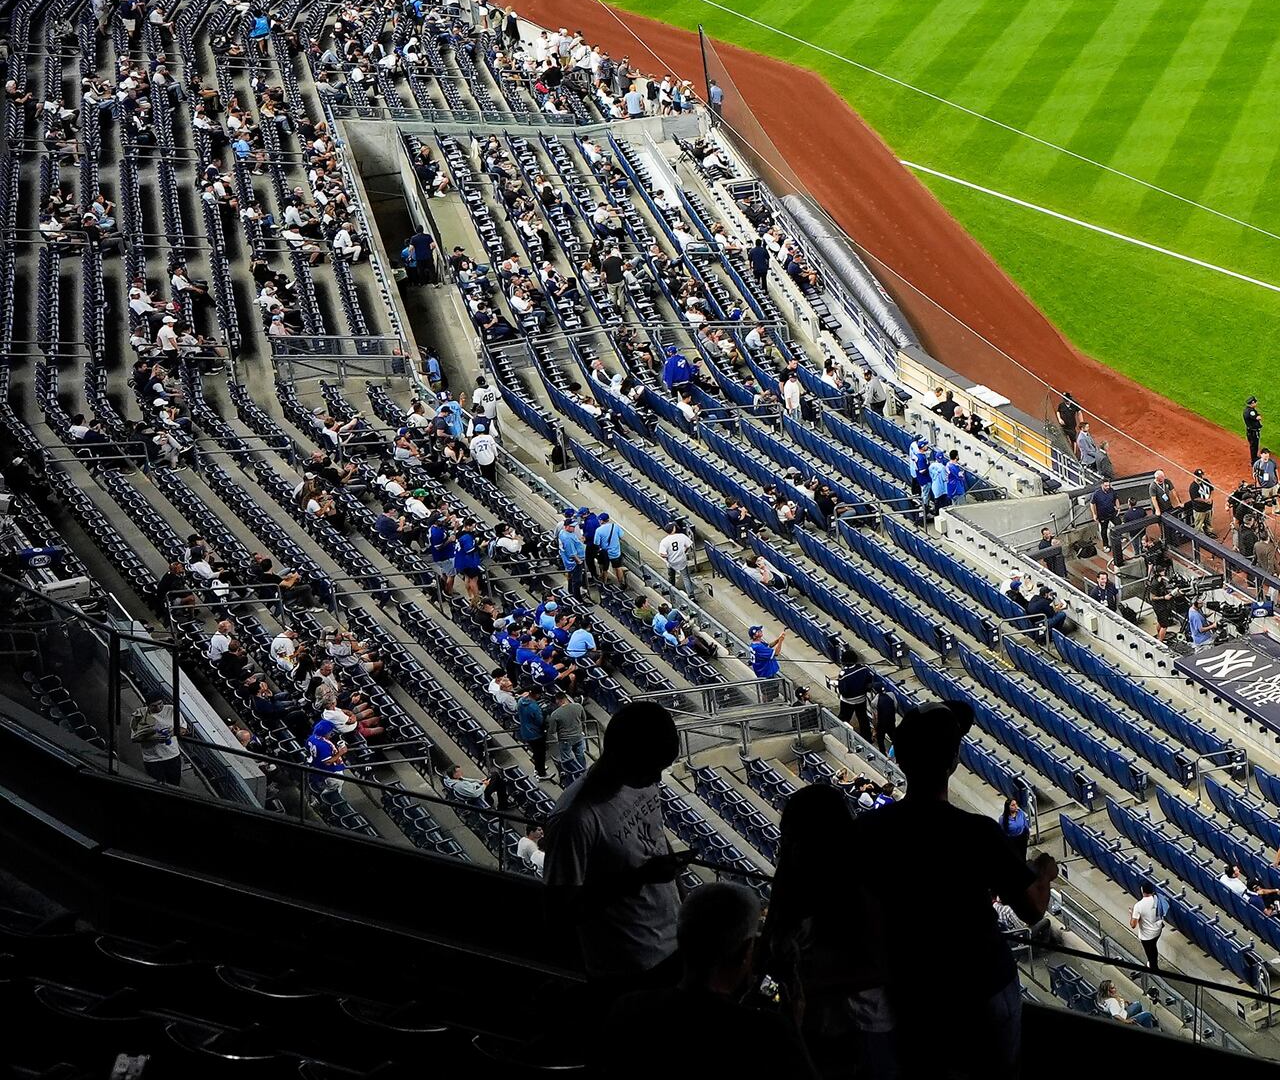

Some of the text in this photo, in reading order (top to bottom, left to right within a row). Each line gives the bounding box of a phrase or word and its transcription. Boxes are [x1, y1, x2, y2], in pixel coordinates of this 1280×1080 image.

[483, 392, 495, 402] 48
[478, 444, 488, 452] 27
[671, 542, 679, 551] 8
[1236, 685, 1269, 707] LIFE
[613, 795, 660, 845] YANKEES
